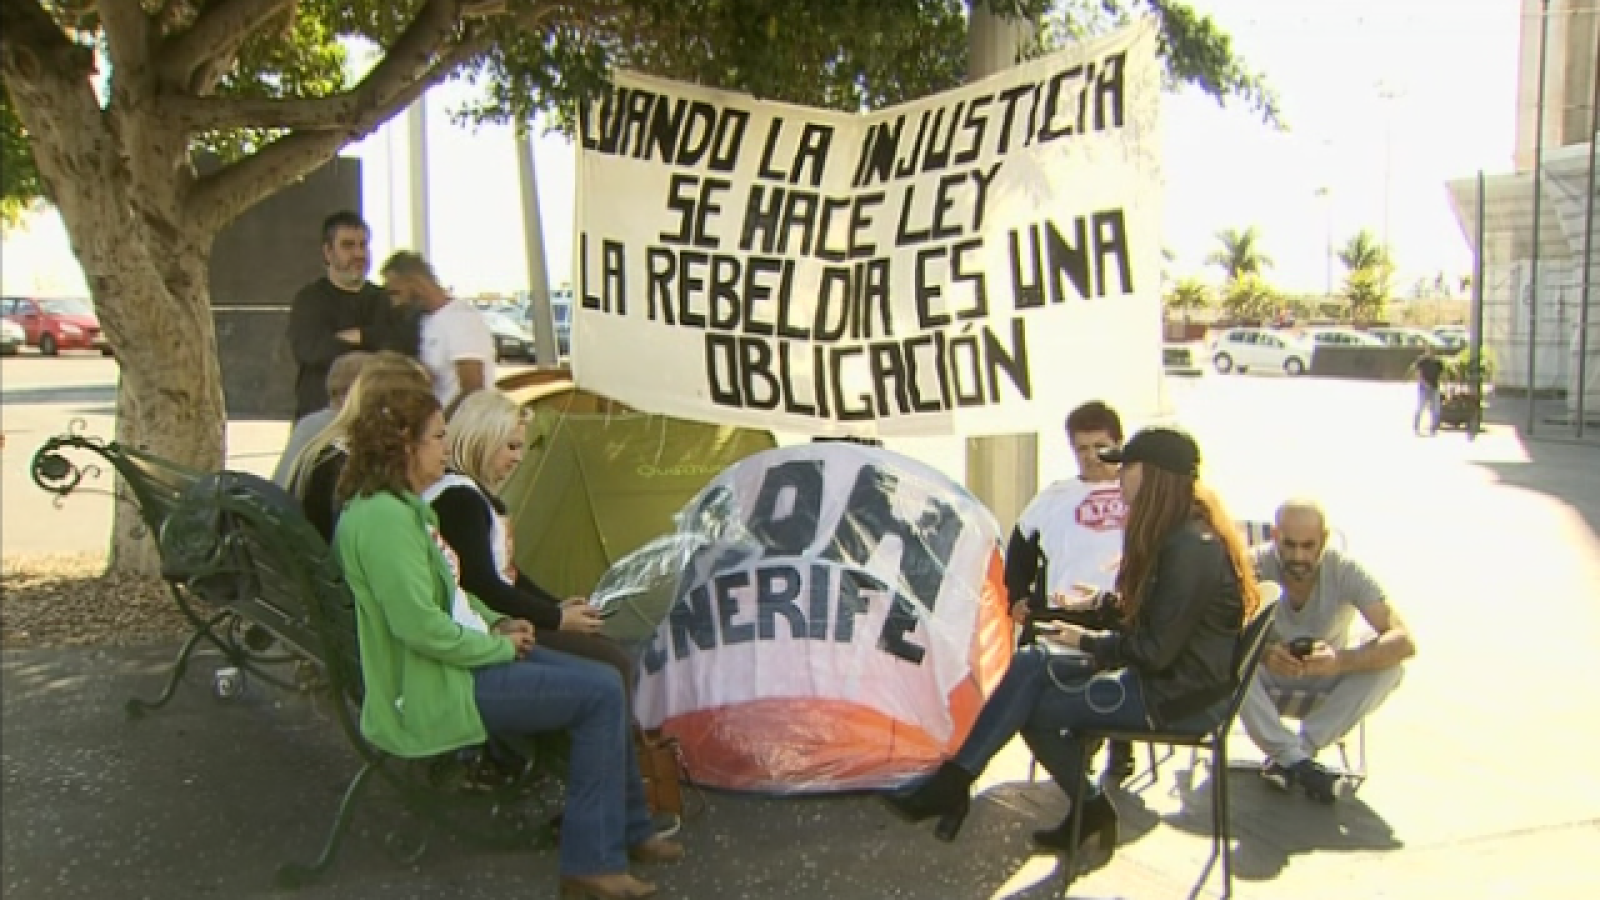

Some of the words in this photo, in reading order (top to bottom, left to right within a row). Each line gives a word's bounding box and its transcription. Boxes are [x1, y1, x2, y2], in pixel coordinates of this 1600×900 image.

[579, 86, 750, 171] CUANDO
[759, 116, 834, 186] LA
[659, 174, 731, 247] SE
[739, 185, 886, 260] HACE
[896, 162, 1001, 246] LEY
[580, 232, 626, 315] LA
[646, 246, 892, 342] REBELDIA
[915, 239, 988, 329] ES
[1009, 207, 1133, 311] UNA
[704, 317, 1032, 420] OBLIGACIÓN
